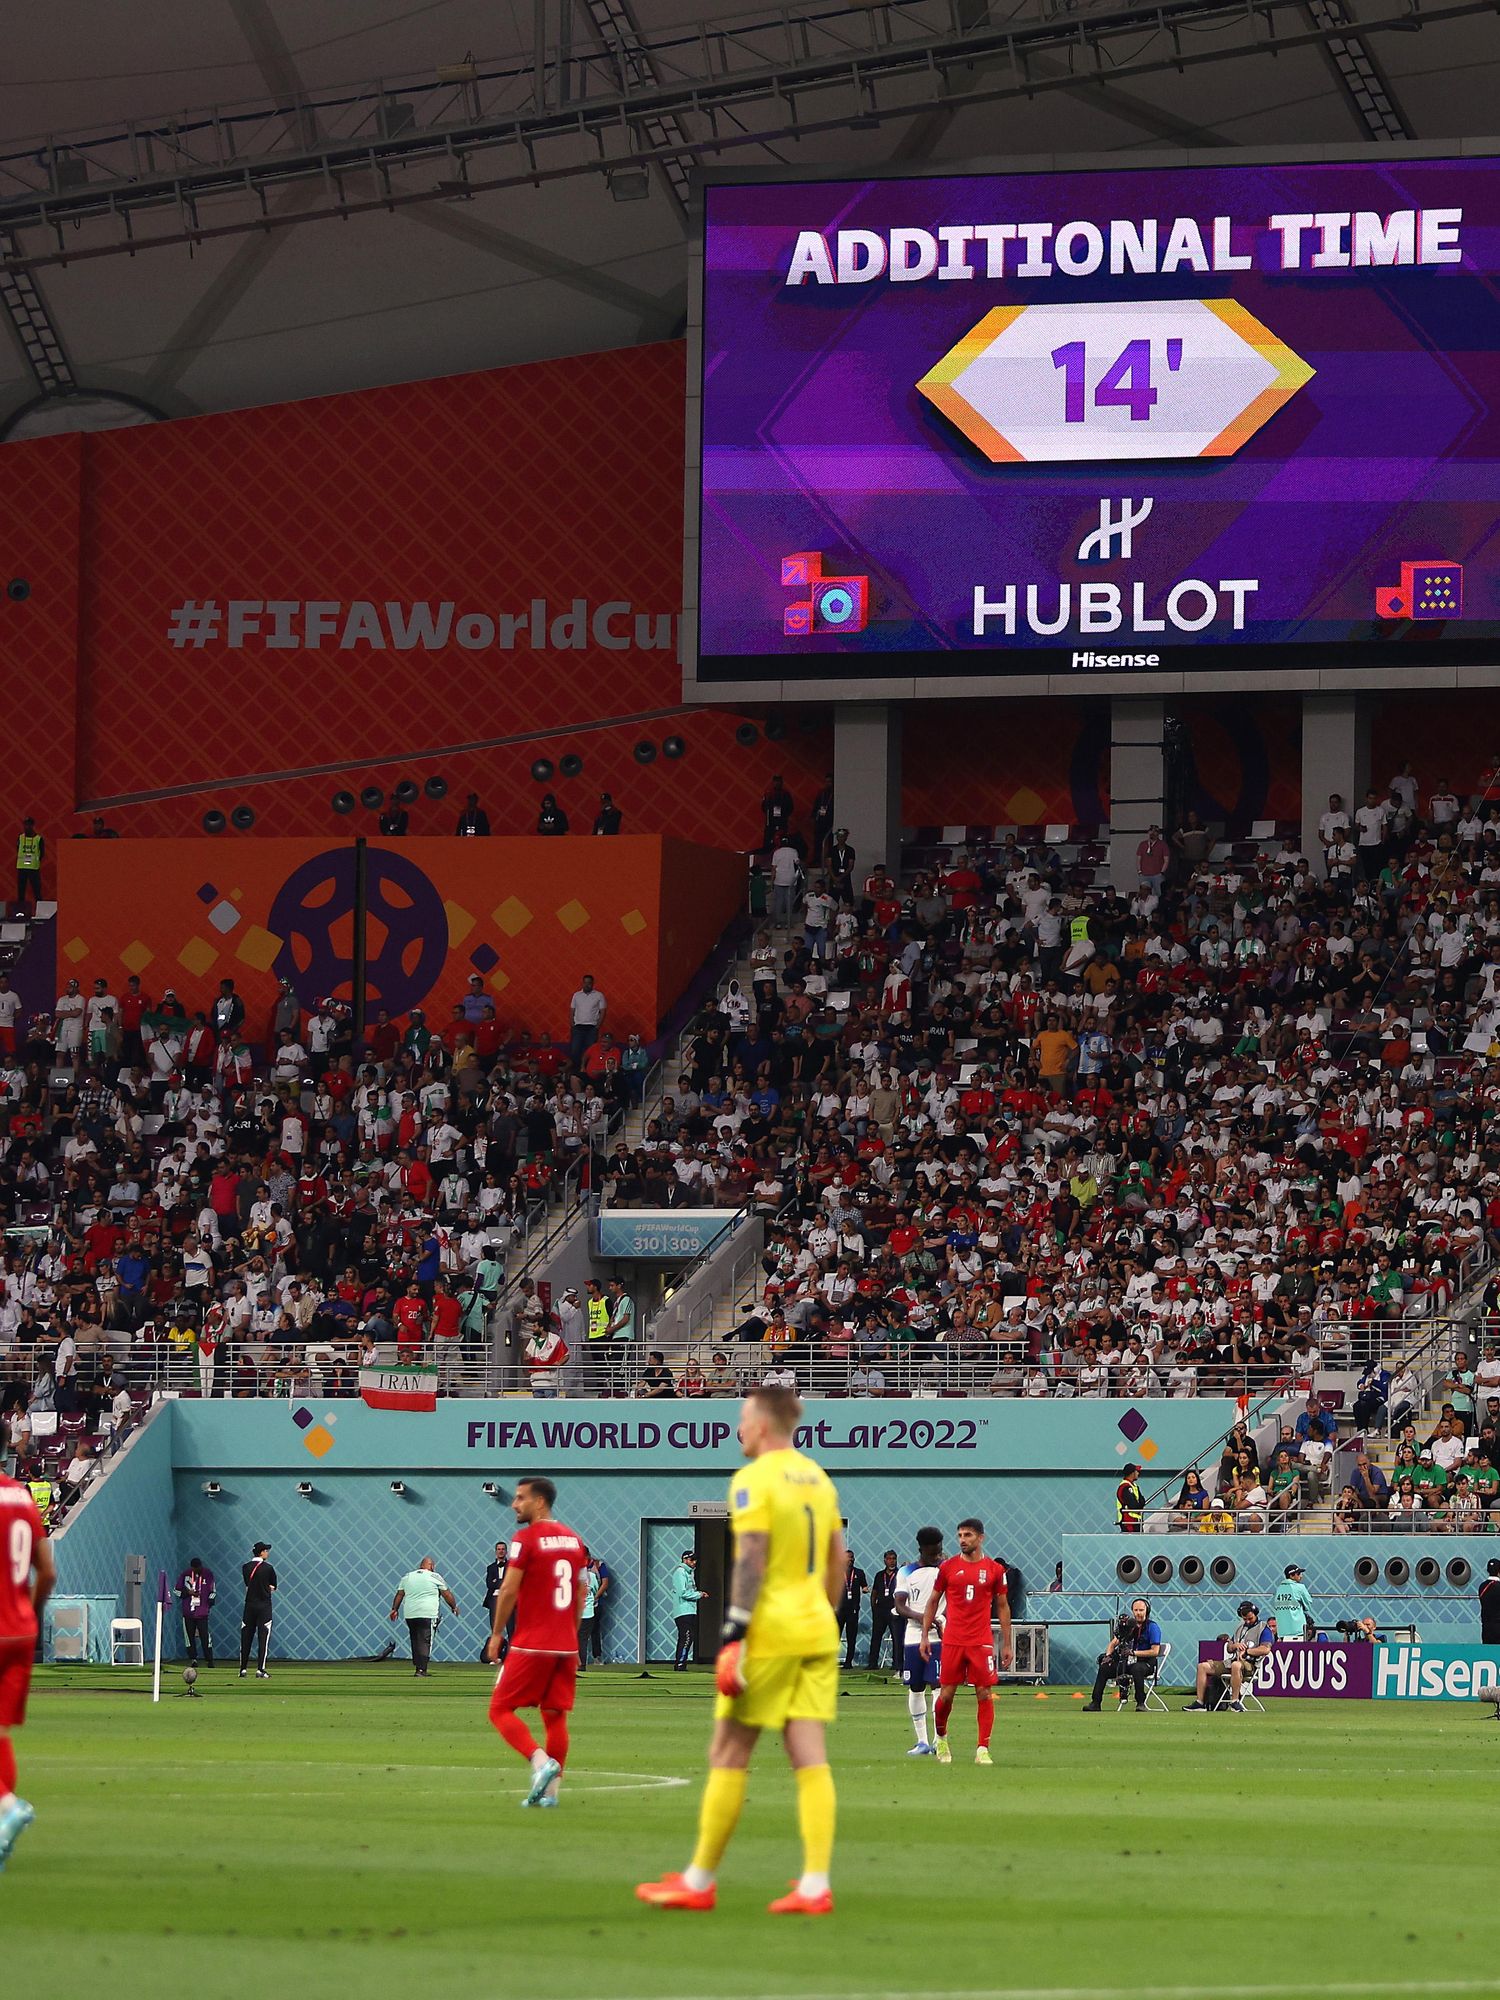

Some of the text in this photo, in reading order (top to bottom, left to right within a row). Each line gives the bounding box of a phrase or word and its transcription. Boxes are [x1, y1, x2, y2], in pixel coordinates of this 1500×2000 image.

[786, 208, 1463, 285] ADDITIONAL TIME
[1051, 338, 1183, 423] 14'
[973, 579, 1259, 636] HUBLOT
[168, 598, 682, 664] #FIFAWorldCu
[1072, 652, 1160, 668] Hisense
[633, 1237, 700, 1251] 310 309
[635, 1223, 700, 1234] #FIFAWorldCup
[379, 1374, 421, 1391] IRAN
[467, 1422, 537, 1448] FIFA
[542, 1422, 661, 1449] WORLD
[667, 1422, 731, 1449] CUP
[10, 1519, 32, 1586] 9
[804, 1505, 815, 1573] 1
[554, 1559, 573, 1610] 3
[966, 1584, 975, 1601] 5
[1277, 1593, 1291, 1601] 4192
[987, 1655, 995, 1672] 5
[1258, 1647, 1500, 1697] BYJU'S Hisen
